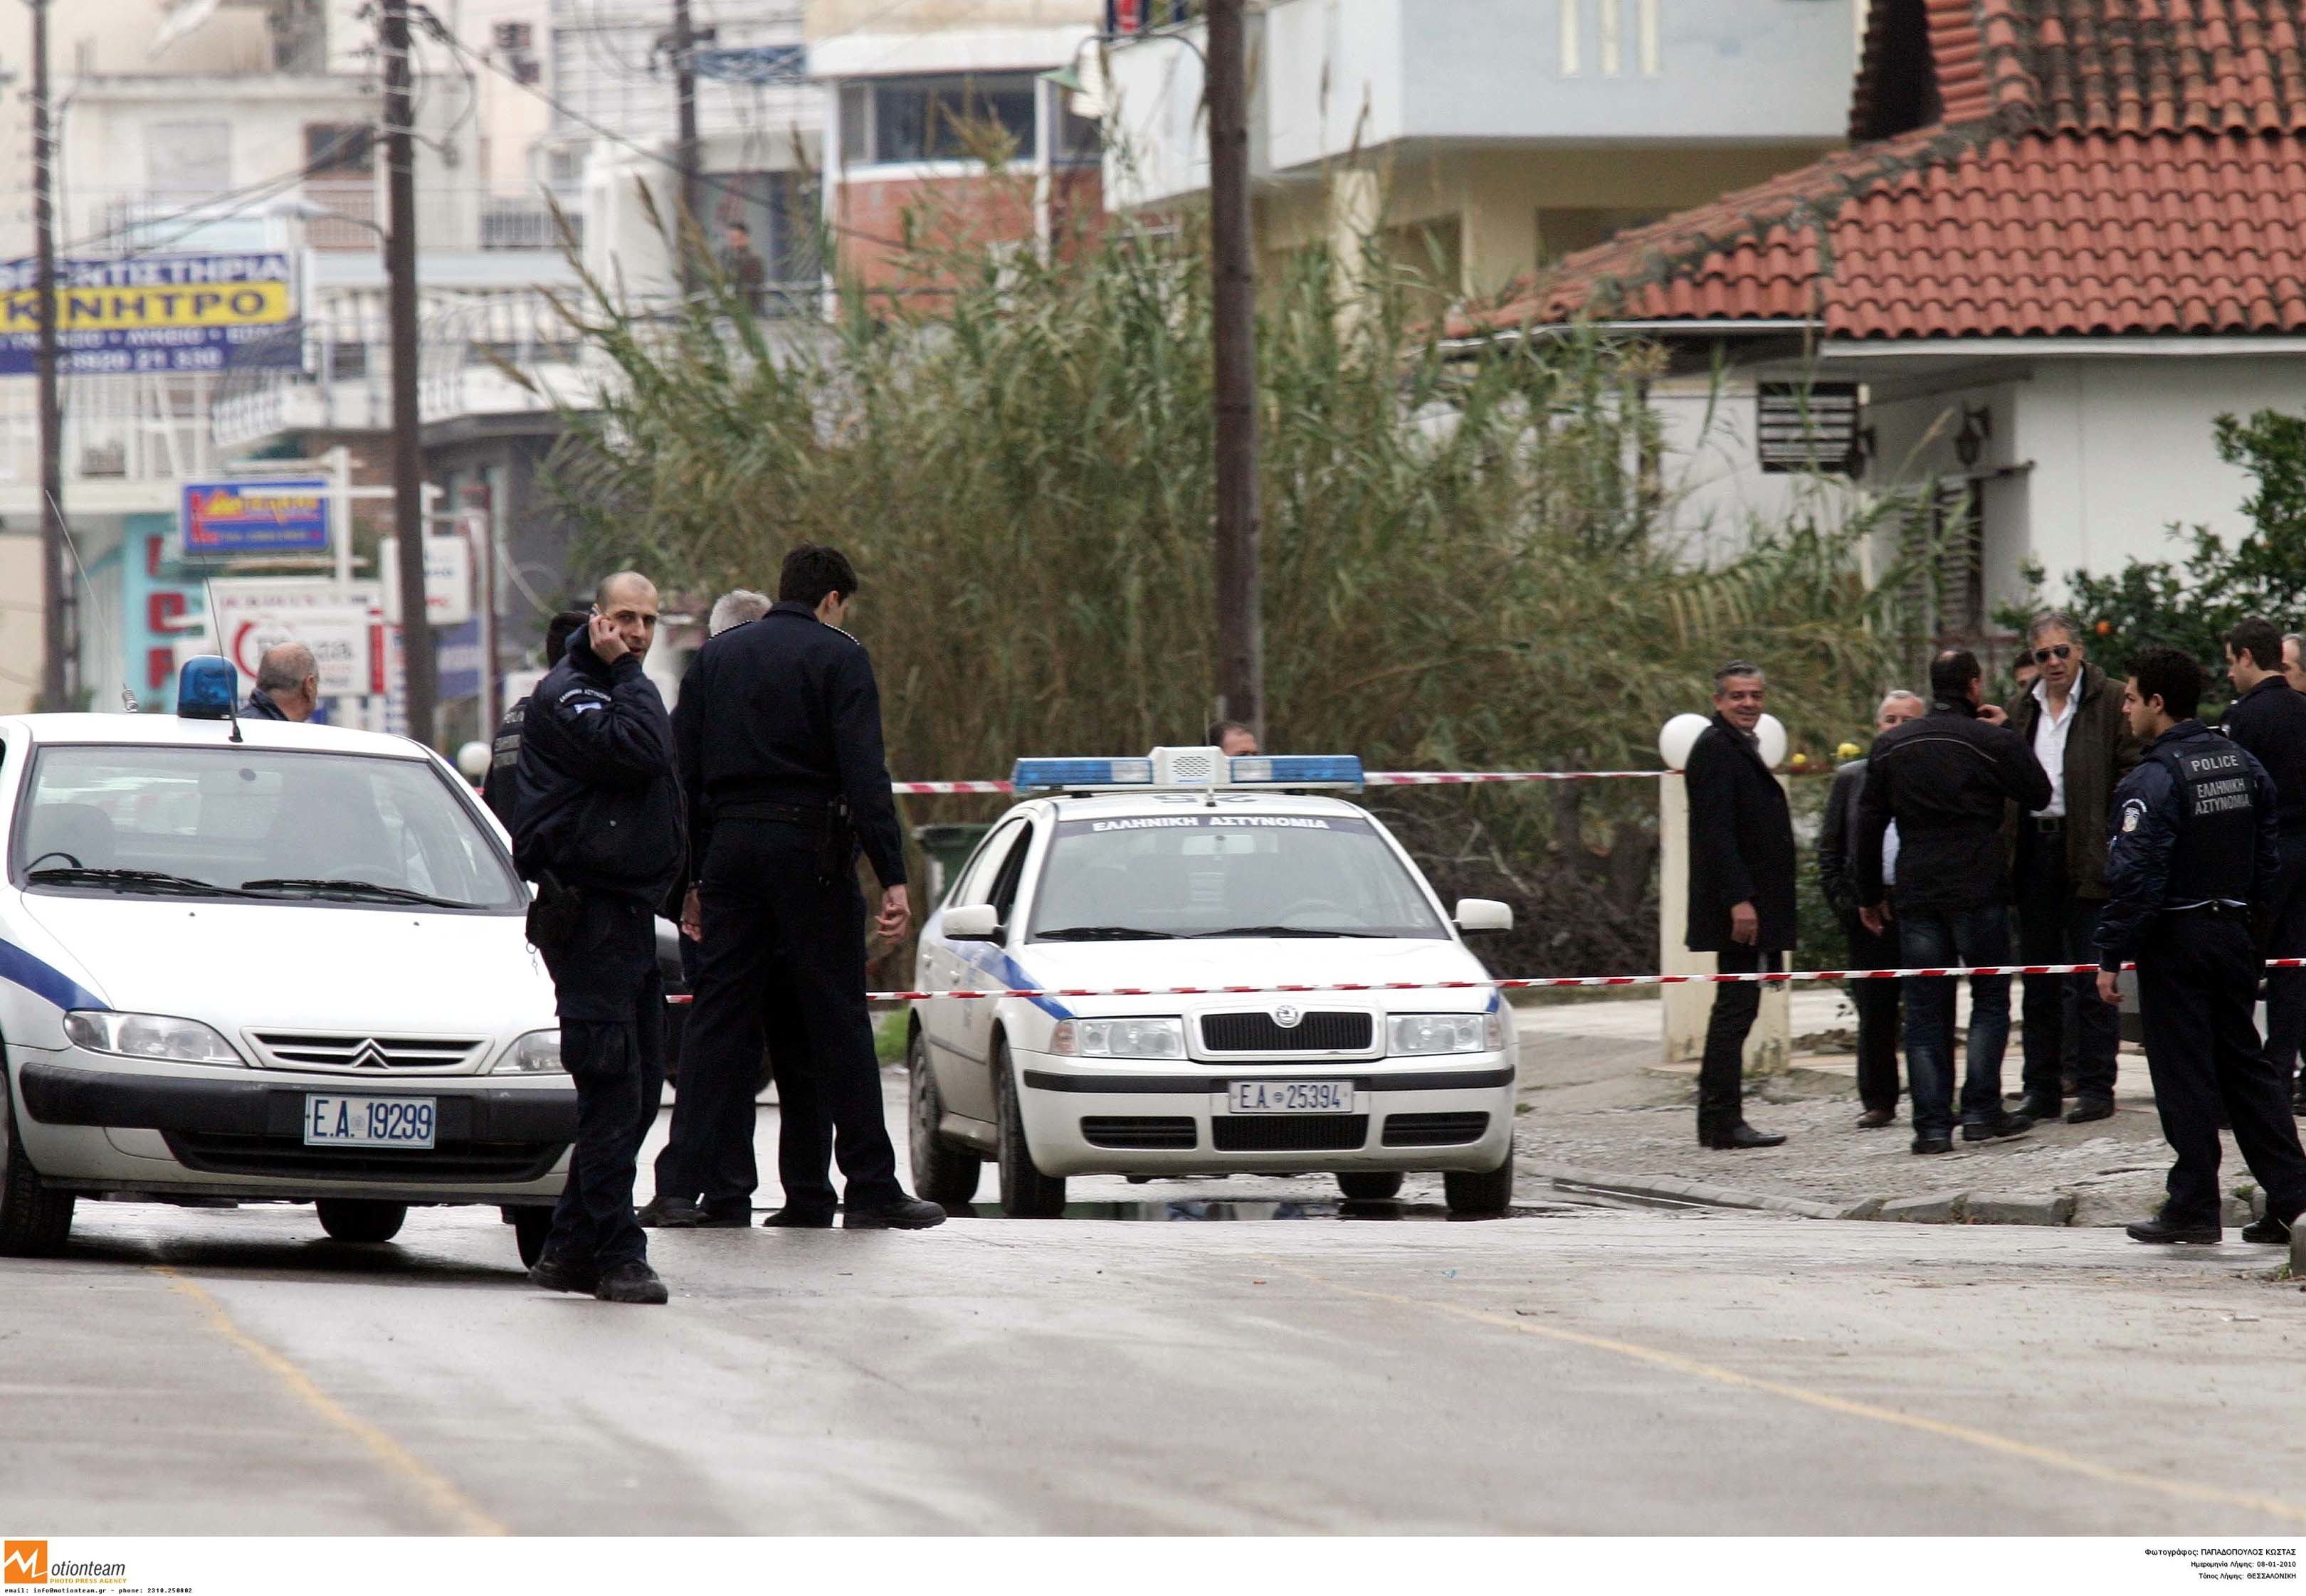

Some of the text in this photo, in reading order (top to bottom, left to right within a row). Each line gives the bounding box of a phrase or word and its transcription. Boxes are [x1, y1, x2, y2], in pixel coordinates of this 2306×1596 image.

[7, 291, 265, 320] ΚΝΗΤΡΟ
[2191, 755, 2238, 772] POLICE
[1093, 816, 1330, 832] ΕΛΛΗΝΙΚΗ ΑΣΤΥΝΟΜΙΑ
[1286, 1084, 1341, 1109] 25394
[366, 1102, 432, 1138] 19299
